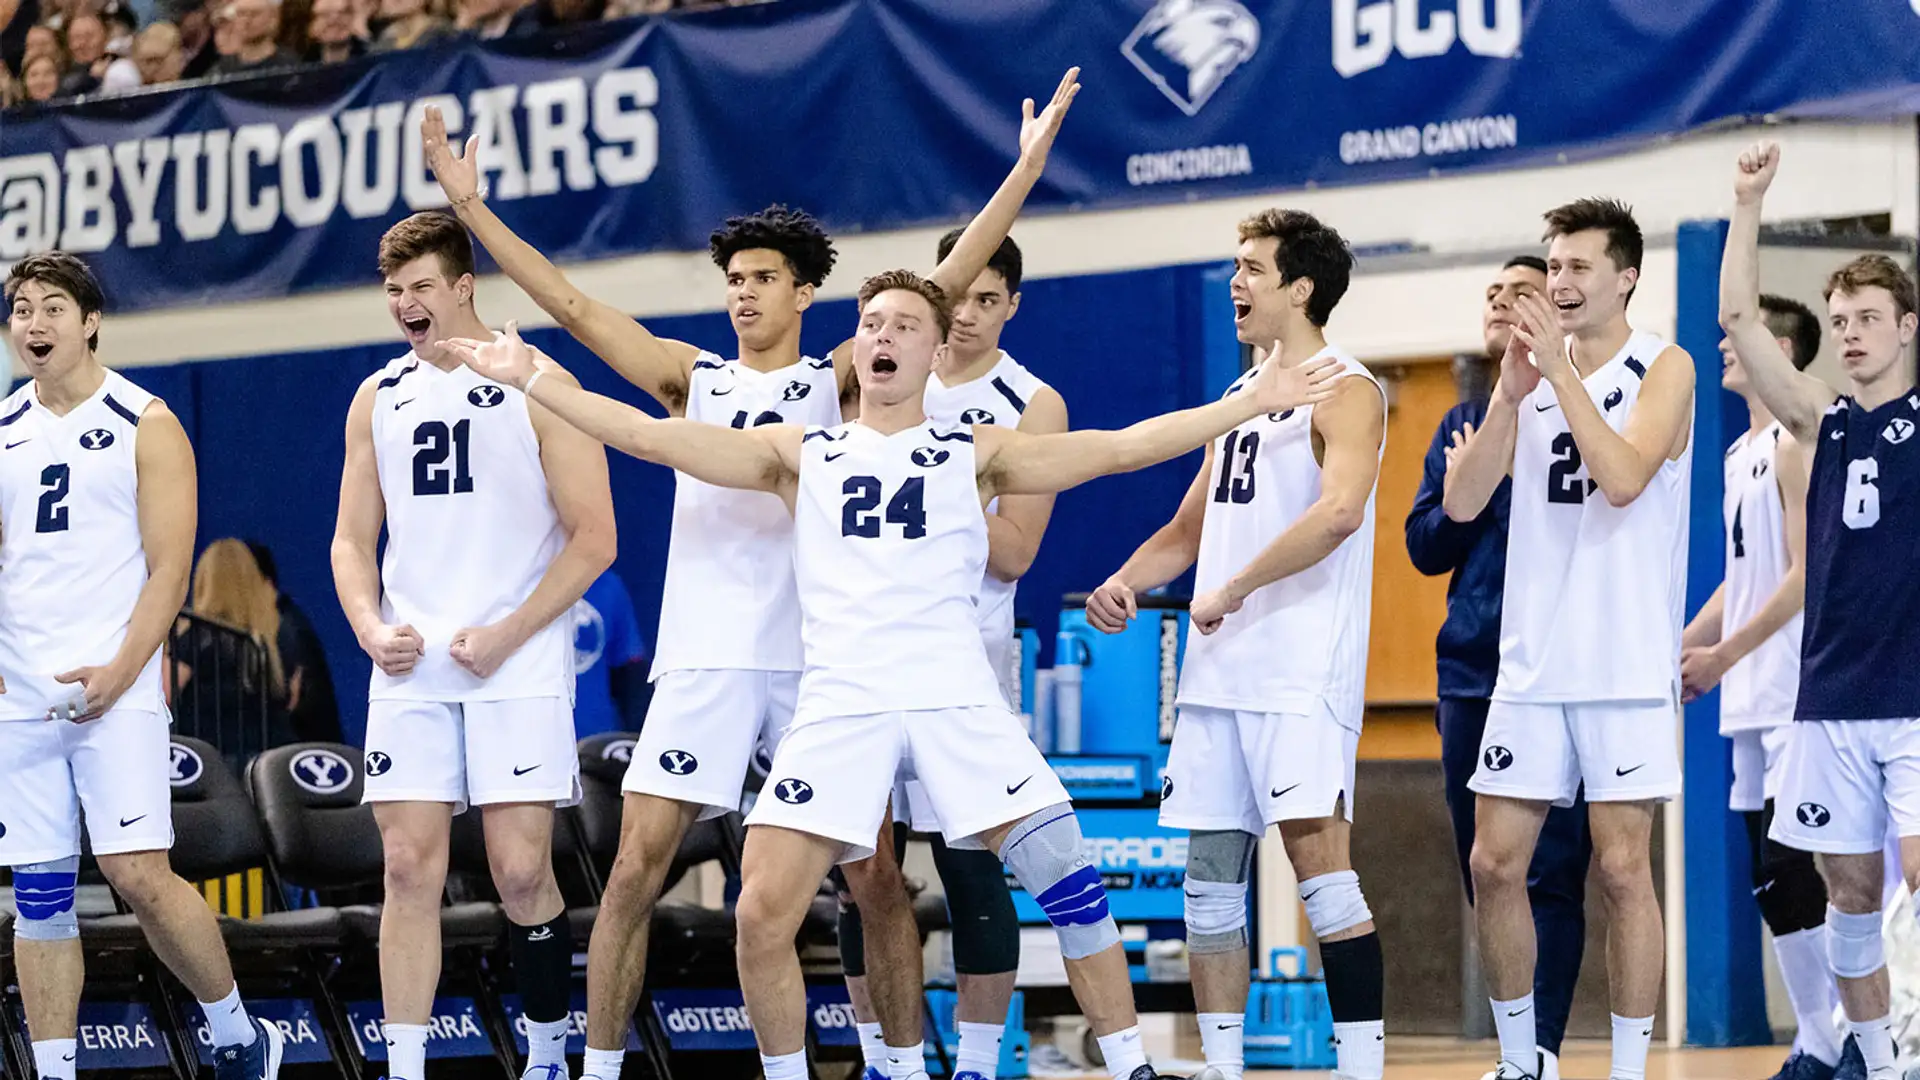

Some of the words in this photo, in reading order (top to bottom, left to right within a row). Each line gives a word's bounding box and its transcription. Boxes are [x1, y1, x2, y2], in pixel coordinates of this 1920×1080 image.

[1339, 125, 1419, 165] GRAND
[1421, 114, 1517, 155] CANYON
[0, 66, 659, 270] @BYUCOUGARS
[1126, 143, 1253, 186] CONCORDIA
[472, 386, 501, 406] Y
[85, 430, 112, 450] Y
[412, 418, 474, 496] 21
[915, 448, 945, 466] Y
[1213, 429, 1260, 504] 13
[1547, 431, 1598, 504] 2
[35, 462, 70, 534] 2
[841, 474, 927, 540] 24
[1842, 456, 1880, 530] 6
[665, 751, 694, 774] Y
[1487, 746, 1510, 769] Y
[780, 780, 809, 803] Y
[1800, 804, 1826, 826] Y
[79, 1024, 155, 1050] ERRA
